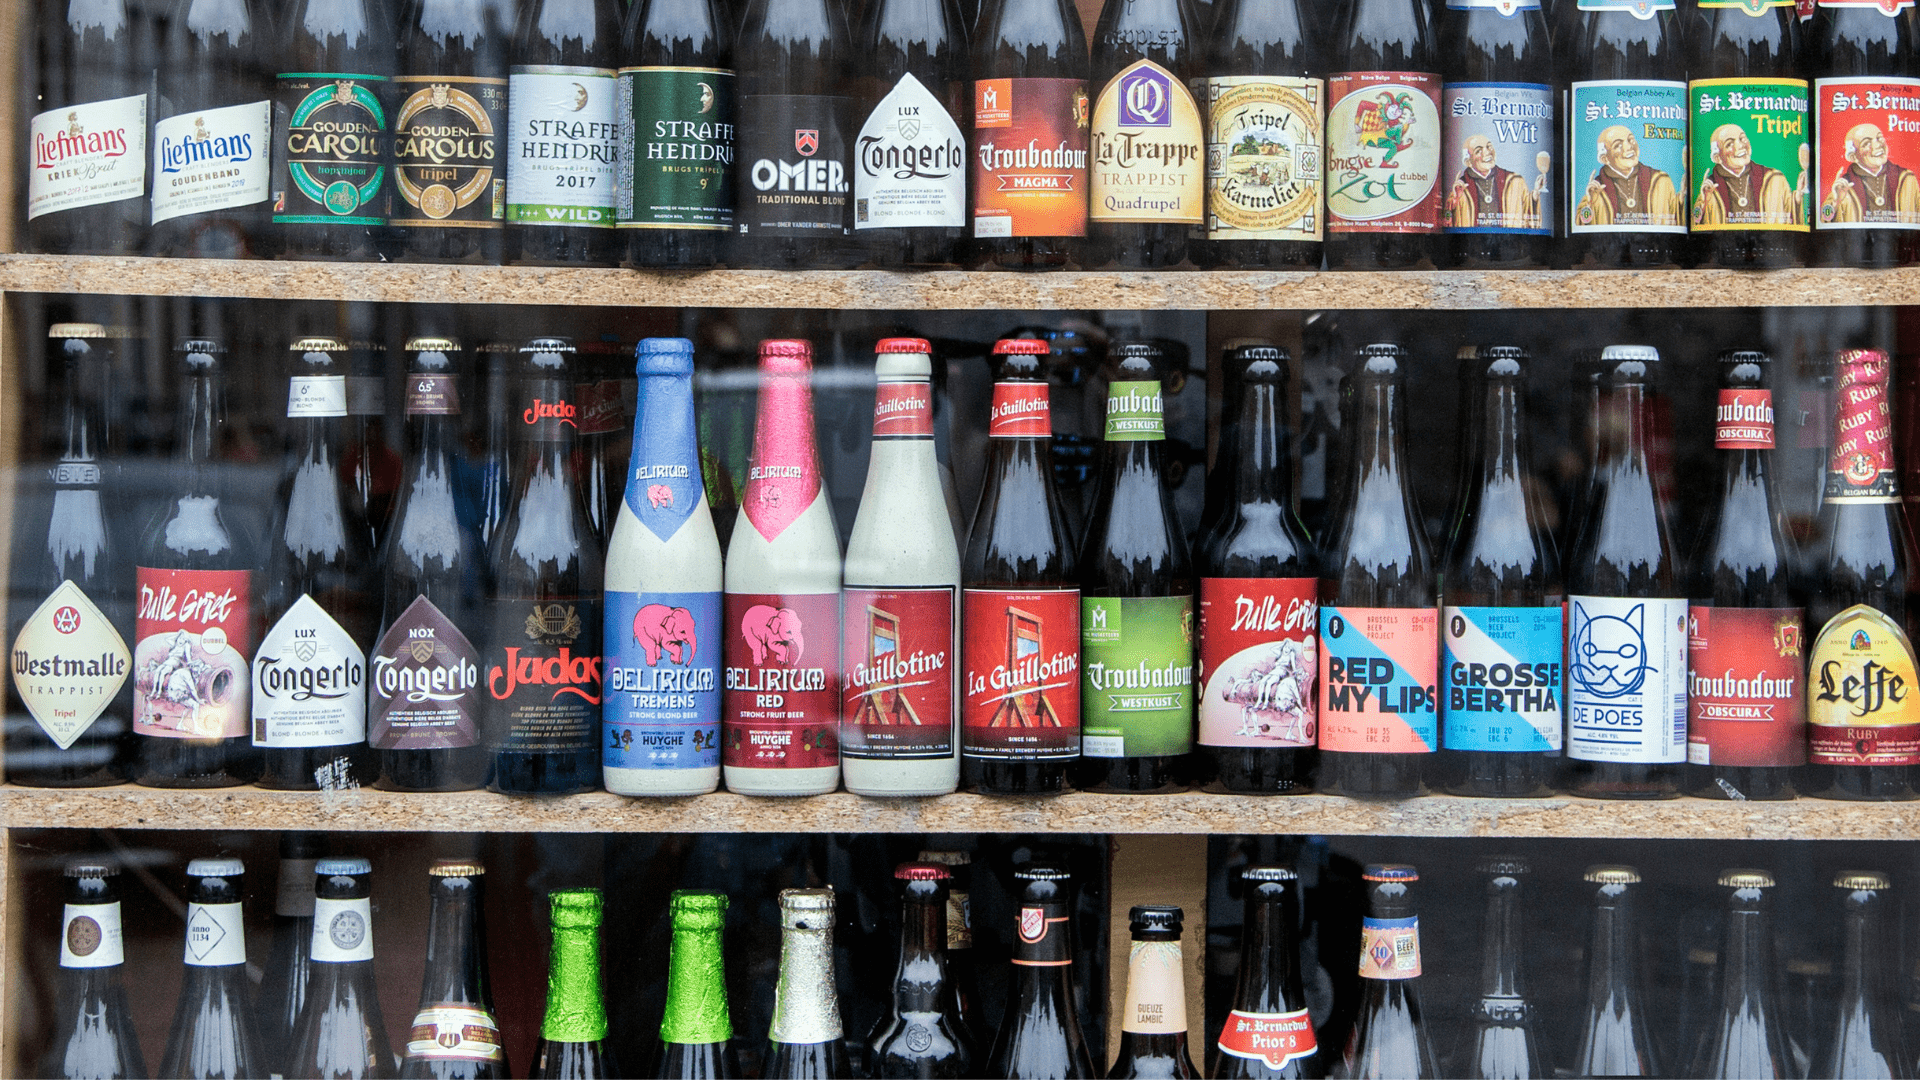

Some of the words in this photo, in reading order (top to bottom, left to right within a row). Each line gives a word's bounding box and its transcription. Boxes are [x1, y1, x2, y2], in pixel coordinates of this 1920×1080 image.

[1494, 89, 1520, 99] Belgian
[1616, 89, 1642, 98] Belgian
[1644, 89, 1665, 99] Abbey
[1741, 85, 1767, 94] Abbey
[1768, 86, 1779, 94] Ale
[1880, 85, 1902, 94] Abbey
[1903, 86, 1913, 94] Ale
[1127, 78, 1164, 123] Q
[1451, 97, 1478, 117] St.
[1699, 92, 1726, 115] St.
[1727, 91, 1808, 114] Bernardus
[1832, 91, 1863, 113] St.
[898, 106, 920, 116] LUX
[1233, 107, 1292, 132] Tripel
[1585, 100, 1614, 121] St.
[312, 122, 372, 133] GOUDEN
[410, 126, 470, 138] GOUDEN
[528, 119, 618, 141] STRAFFE
[1493, 119, 1538, 144] Wit
[1643, 123, 1684, 141] EXTRA
[1750, 114, 1803, 139] Tripel
[36, 127, 127, 169] Liefmans
[161, 133, 252, 174] Liefmans
[393, 138, 495, 164] CAROLUS
[979, 138, 1087, 172] Troubadour
[1092, 132, 1113, 170] La
[1114, 130, 1199, 169] Trappe
[859, 136, 961, 180] Tongerlo
[1329, 142, 1376, 178] brugse
[47, 168, 80, 182] KRIEK
[79, 159, 119, 180] Brut
[172, 168, 241, 187] GOUDENBAND
[317, 165, 367, 176] hopsinjoor
[419, 168, 458, 182] tripel
[662, 165, 692, 173] BRUGS
[751, 158, 850, 193] OMER.
[1399, 172, 1428, 182] dubbel
[555, 174, 597, 188] 2017
[1013, 177, 1059, 188] MAGMA
[1101, 172, 1188, 186] TRAPPIST
[1331, 172, 1414, 203] Zot
[756, 195, 820, 205] TRADITIONAL
[1222, 178, 1300, 209] Karmeliet
[1105, 195, 1181, 212] Quadrupel
[545, 207, 602, 221] WILD
[1849, 384, 1882, 404] RUBY
[876, 397, 926, 417] Guillotine
[1000, 397, 1049, 416] Guillotine
[1116, 420, 1159, 430] WESTKUST
[1838, 409, 1872, 432] RUBY
[1719, 429, 1764, 439] OBSCURA
[636, 465, 689, 480] DELIRIUM
[750, 465, 802, 481] DELIRIUM
[138, 583, 175, 622] Dulle
[177, 583, 237, 623] Griet
[1092, 609, 1107, 628] M
[1230, 593, 1281, 632] Dulle
[295, 628, 317, 638] LUX
[409, 628, 435, 638] NOX
[1488, 631, 1516, 639] PROJECT
[14, 650, 125, 678] Westmalle
[853, 650, 945, 687] Guillotine
[1329, 656, 1394, 685] RED
[258, 656, 361, 701] Tongerlo
[373, 655, 477, 703] Tongerlo
[489, 647, 601, 705] Judas
[612, 667, 714, 692] DELIRIUM
[726, 667, 826, 692] DELIRIUM
[968, 671, 986, 696] La
[989, 651, 1077, 690] Guillotine
[1450, 662, 1560, 687] GROSSE
[29, 685, 104, 695] TRAPPIST
[1816, 659, 1909, 717] Leffe
[631, 694, 696, 709] TREMENS
[756, 694, 784, 708] RED
[1121, 697, 1173, 708] WESTKUST
[1328, 685, 1372, 713] MY
[1379, 685, 1435, 714] LIPS
[1450, 688, 1557, 713] BERTHA
[53, 708, 77, 719] Tripel
[629, 711, 656, 719] STRONG
[657, 711, 681, 719] BLOND
[682, 711, 698, 719] BEER
[740, 711, 765, 719] STRONG
[787, 711, 804, 719] BEER
[1573, 706, 1588, 724] DE
[1594, 708, 1643, 726] POES
[1707, 706, 1761, 718] OBSCURA
[643, 736, 684, 745] HUYGHE
[750, 735, 791, 745] HUYGHE
[1366, 735, 1378, 743] EBC
[1382, 735, 1390, 743] 20
[1847, 728, 1880, 740] RUBY
[192, 933, 210, 942] 1134
[1375, 947, 1387, 959] 10
[1397, 942, 1414, 952] BEER
[1137, 1003, 1163, 1013] GUEUZE
[1137, 1014, 1164, 1024] LAMBIC
[1236, 1019, 1253, 1032] St.
[1253, 1019, 1308, 1033] Bernardus
[1252, 1033, 1285, 1049] Prior
[1289, 1035, 1297, 1048] 8
